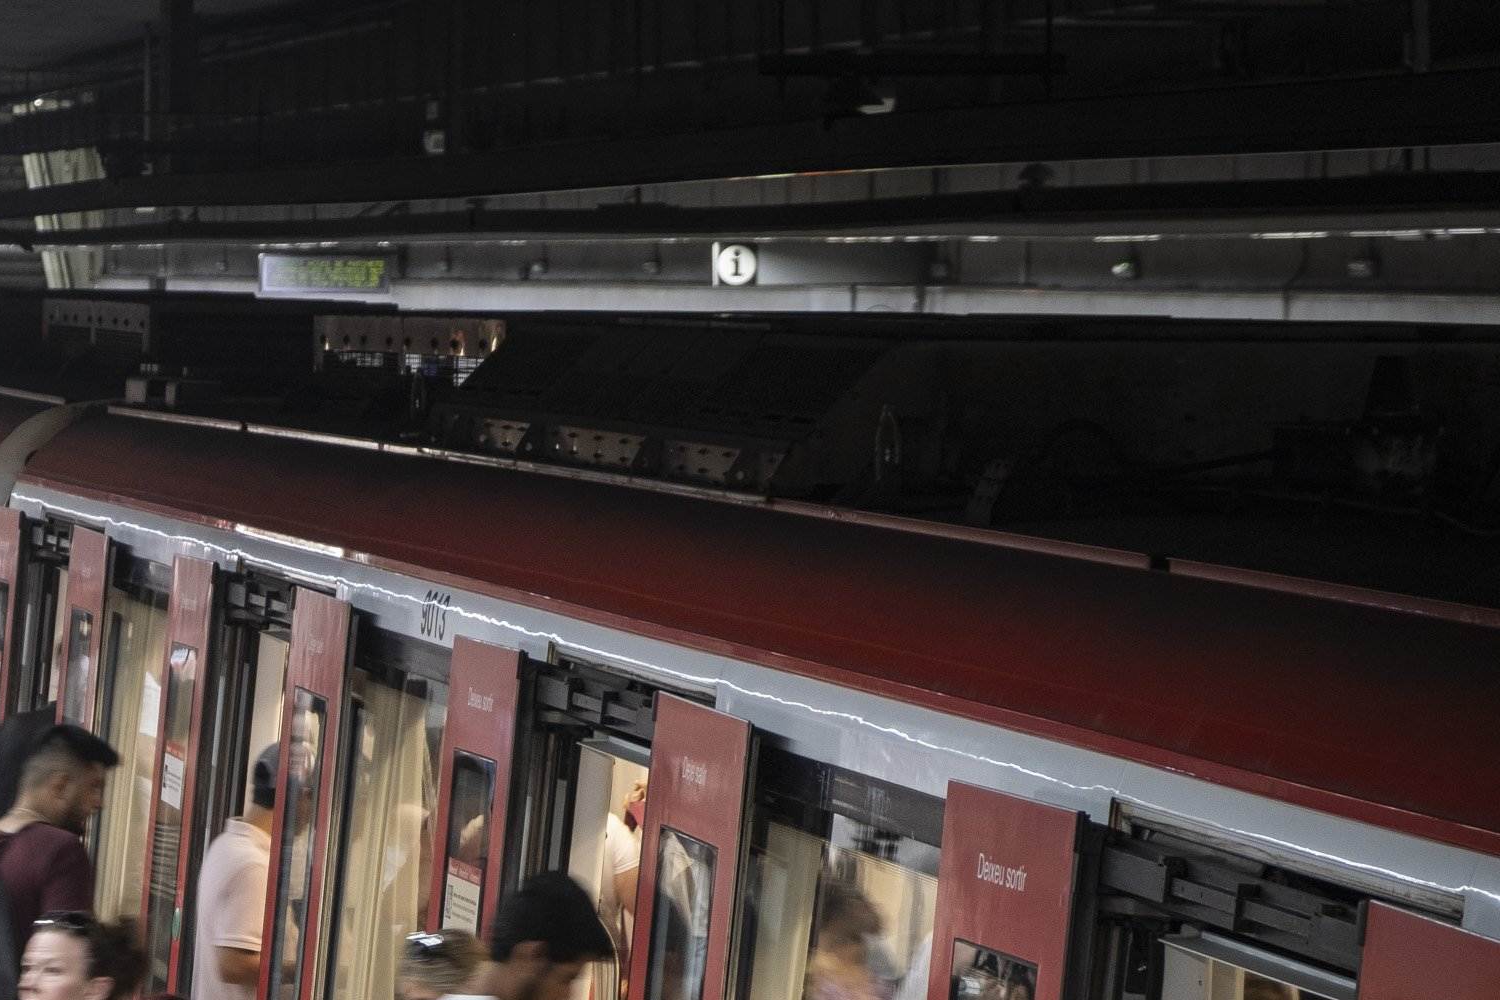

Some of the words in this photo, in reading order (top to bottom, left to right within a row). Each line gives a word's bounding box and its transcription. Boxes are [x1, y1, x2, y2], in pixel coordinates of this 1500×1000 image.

[420, 589, 451, 641] 9013
[977, 852, 1005, 886] Deixeu
[1005, 864, 1027, 891] sortir
